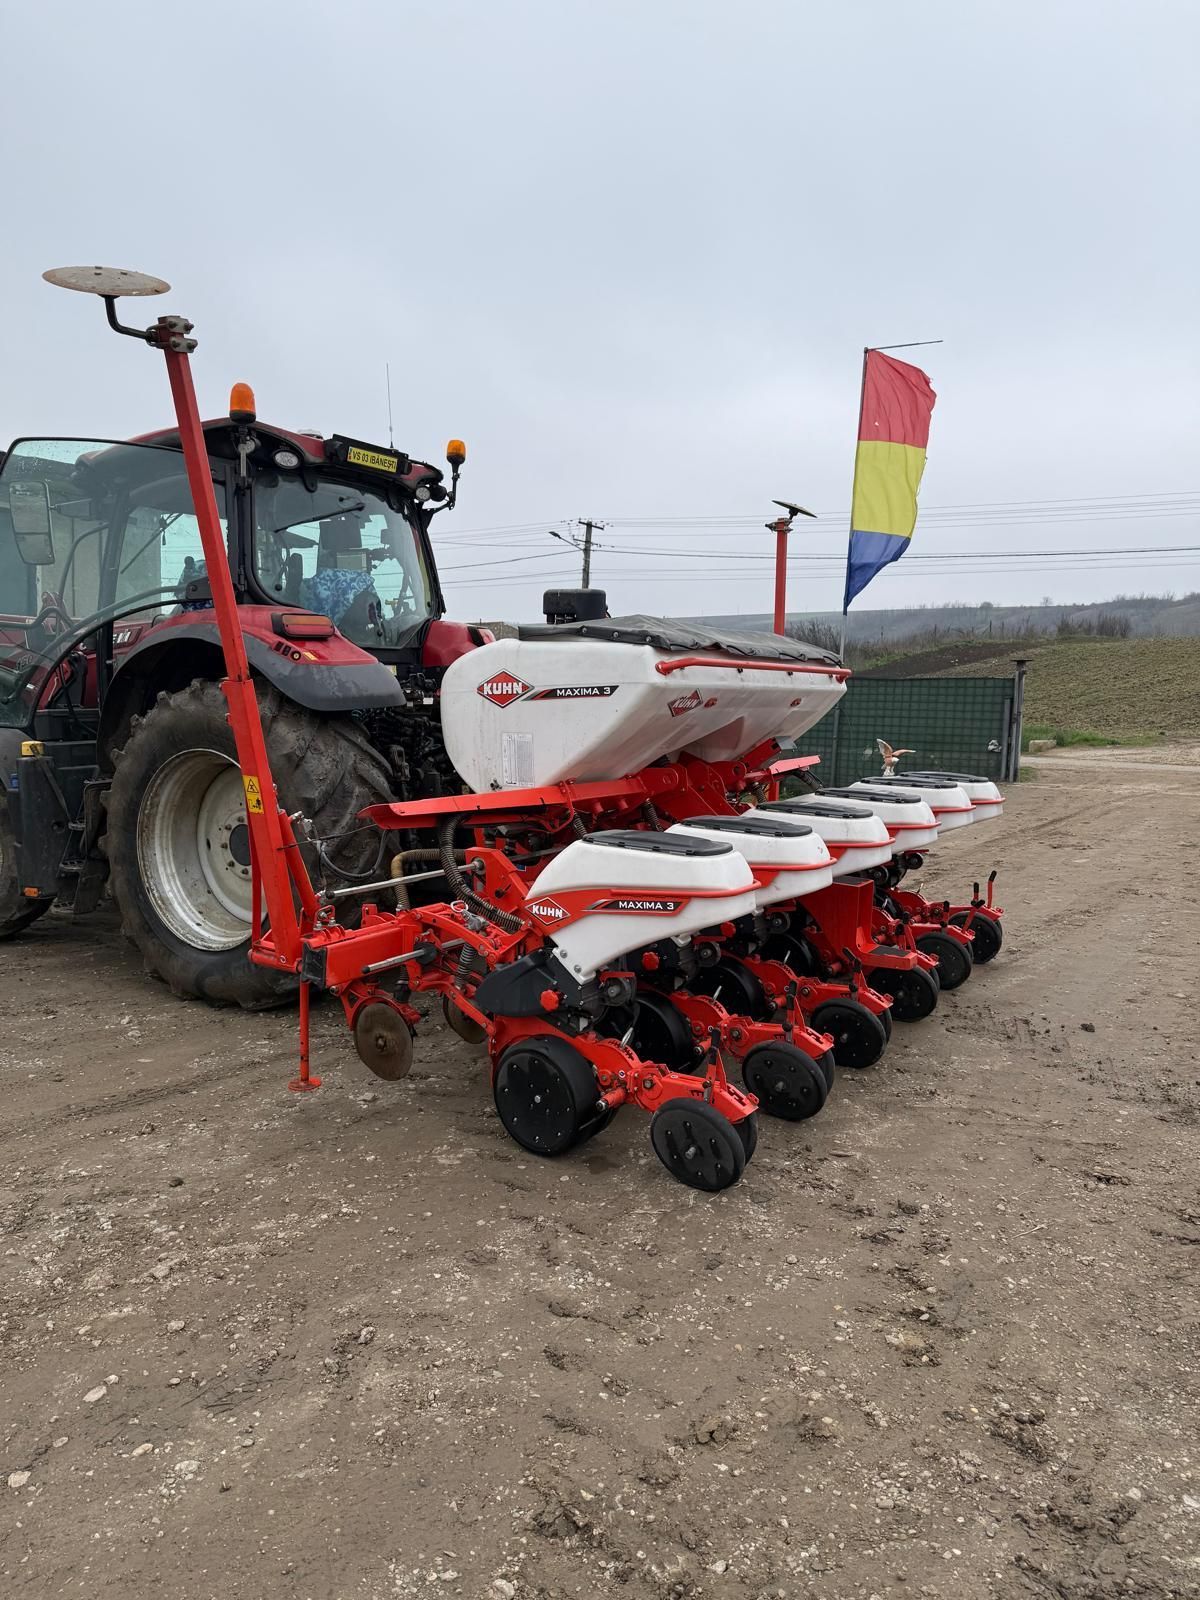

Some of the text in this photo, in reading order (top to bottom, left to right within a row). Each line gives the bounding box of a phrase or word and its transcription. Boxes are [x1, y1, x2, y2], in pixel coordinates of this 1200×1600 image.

[353, 450, 361, 461] VS
[362, 453, 369, 462] 03
[483, 682, 523, 695] KUHN
[556, 687, 611, 697] MAXIMA 3
[532, 904, 563, 918] KUHN
[618, 900, 674, 910] MAXIMA 3
